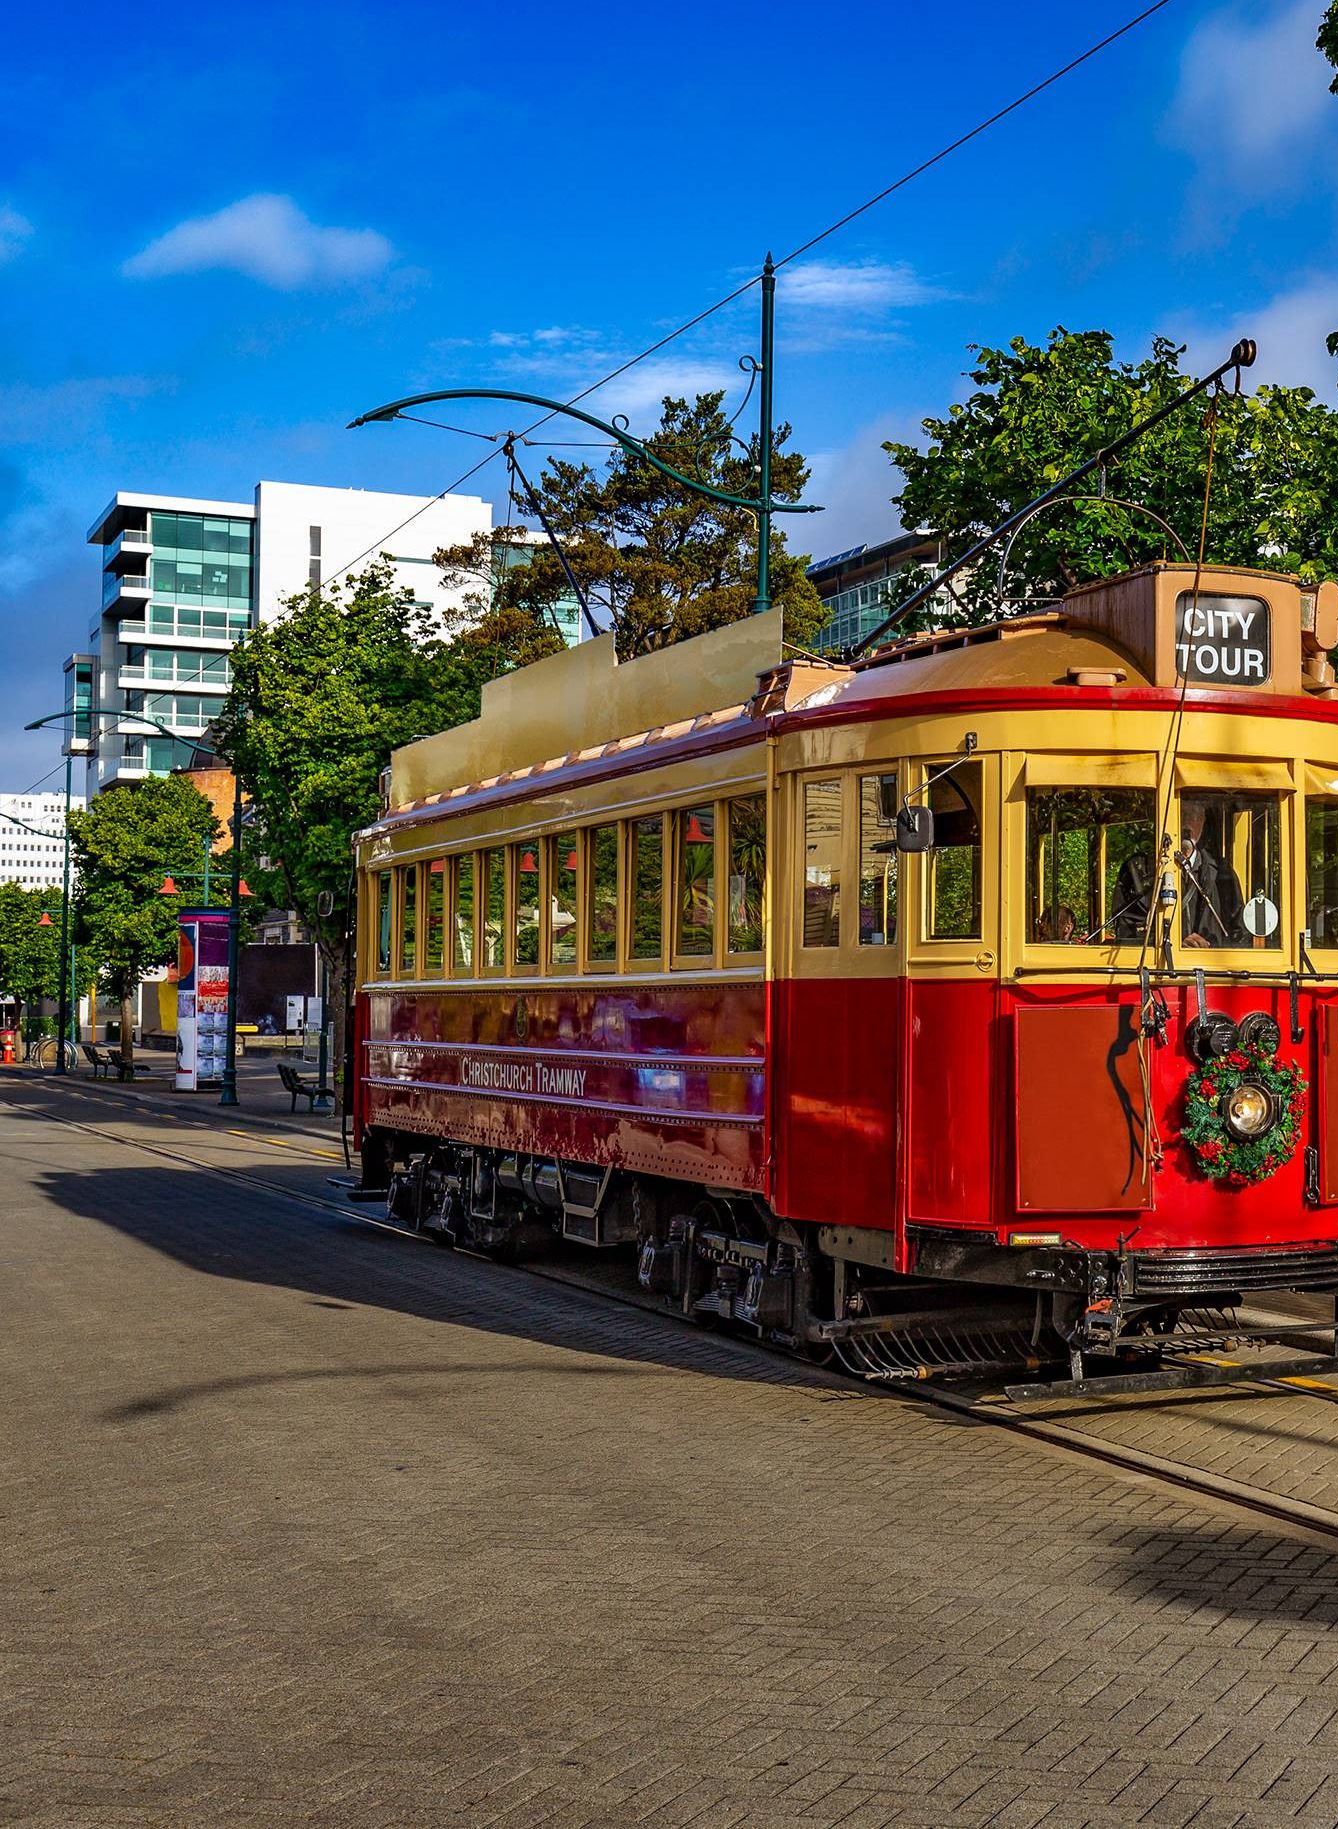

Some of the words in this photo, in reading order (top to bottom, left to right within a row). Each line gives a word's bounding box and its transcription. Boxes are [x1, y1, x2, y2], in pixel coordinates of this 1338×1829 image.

[1184, 607, 1255, 640] CITY
[1177, 643, 1264, 677] TOUR
[461, 1056, 533, 1091] CHRISTCHURCH
[535, 1062, 587, 1096] TRAMWAY
